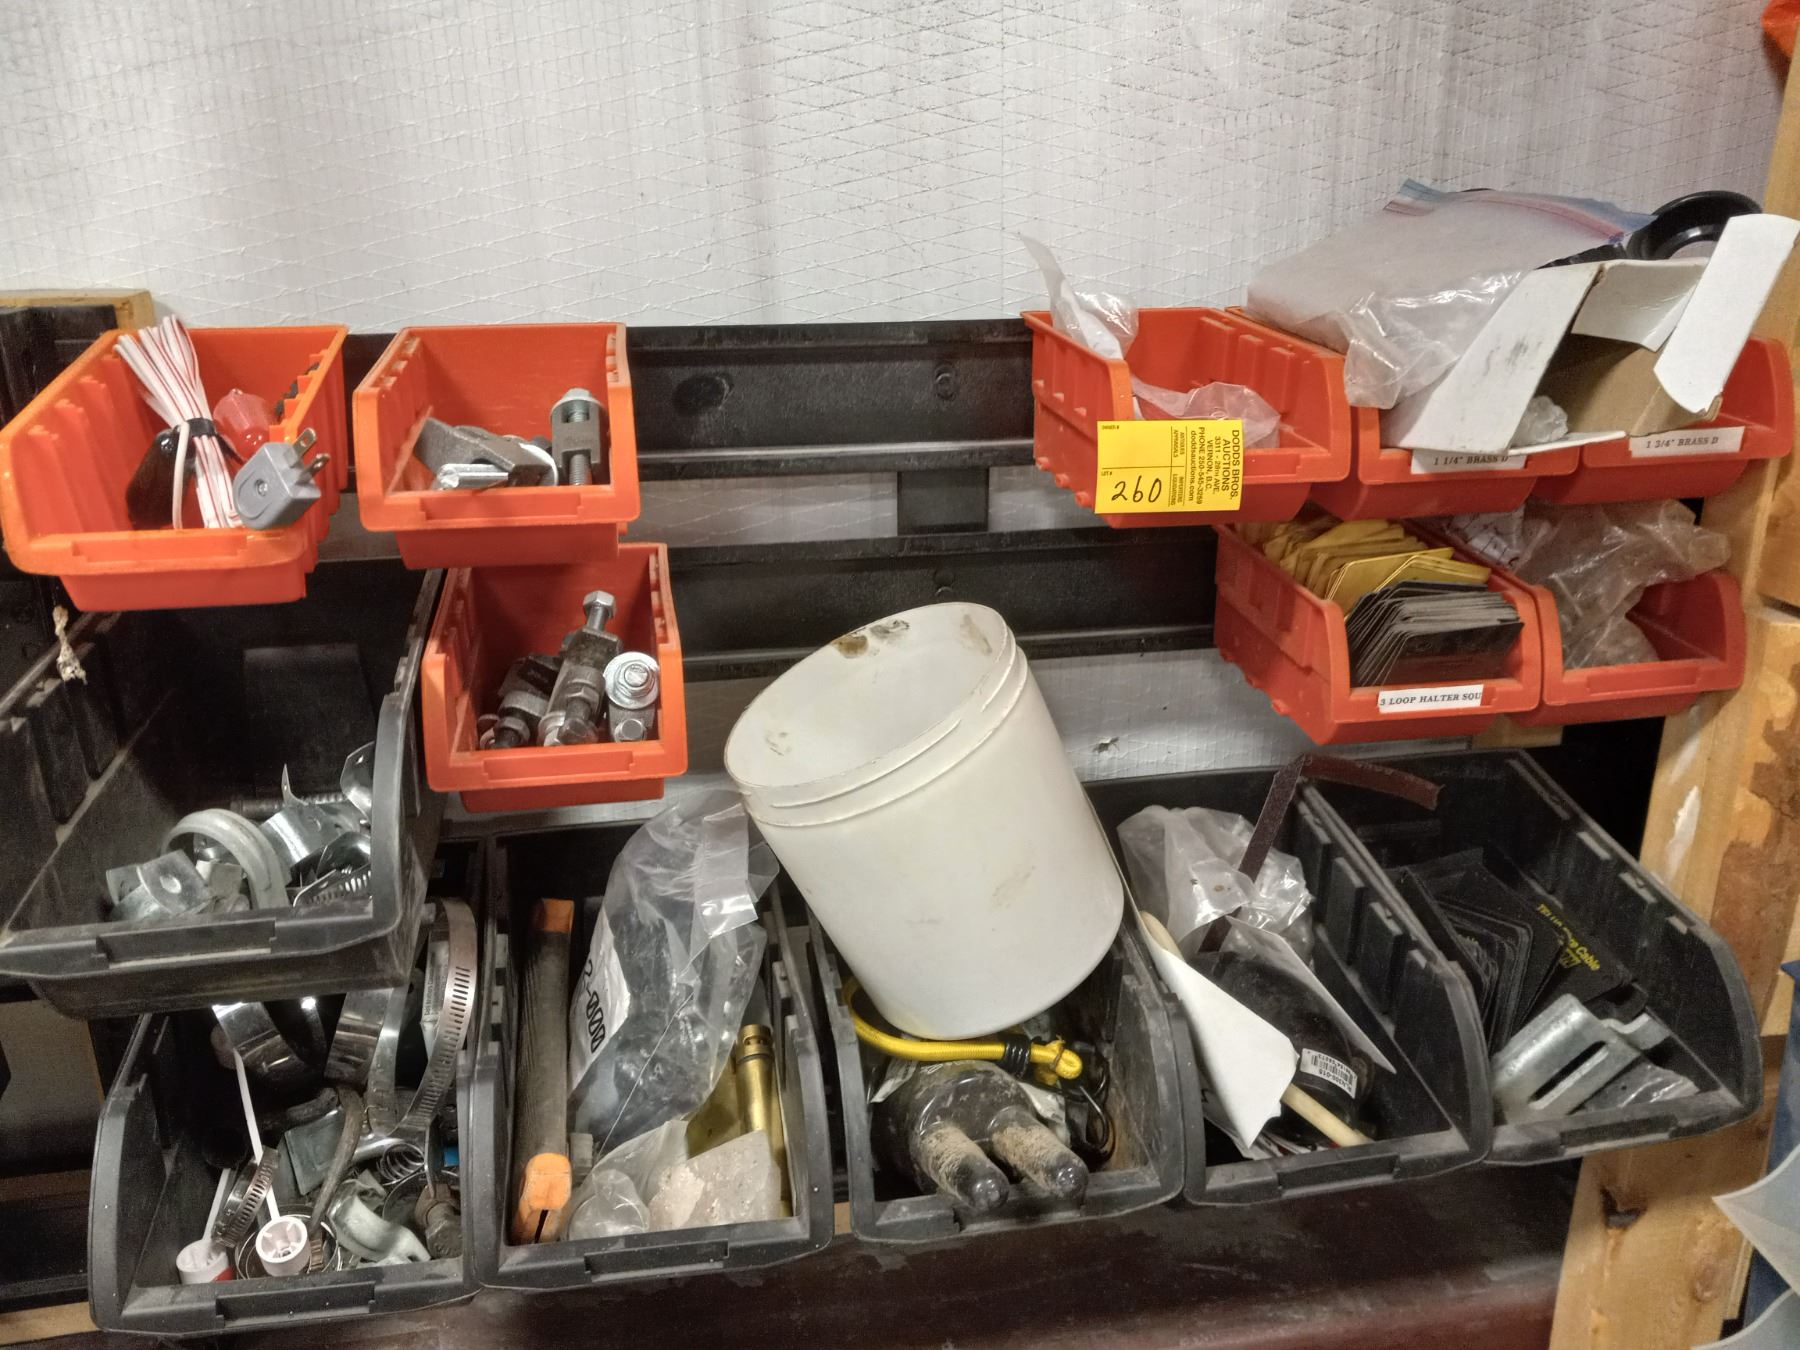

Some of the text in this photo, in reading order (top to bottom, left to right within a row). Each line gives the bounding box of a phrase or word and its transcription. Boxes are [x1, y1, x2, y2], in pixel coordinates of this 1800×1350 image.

[1198, 426, 1206, 454] PHONE
[1646, 436, 1719, 449] 1 3/4" BRASS D
[1188, 430, 1197, 502] doddsauctions.com
[1205, 439, 1213, 475] VERNON,
[1221, 438, 1231, 492] AUCTIONS
[1230, 429, 1240, 500] DODDS BROS.
[1433, 456, 1439, 466] 1
[1443, 456, 1463, 465] 1/4"
[1466, 455, 1498, 465] BRASS
[1111, 475, 1162, 503] 260
[1379, 698, 1386, 706] 3
[1388, 696, 1416, 706] LOOP
[1419, 694, 1460, 704] HALTER
